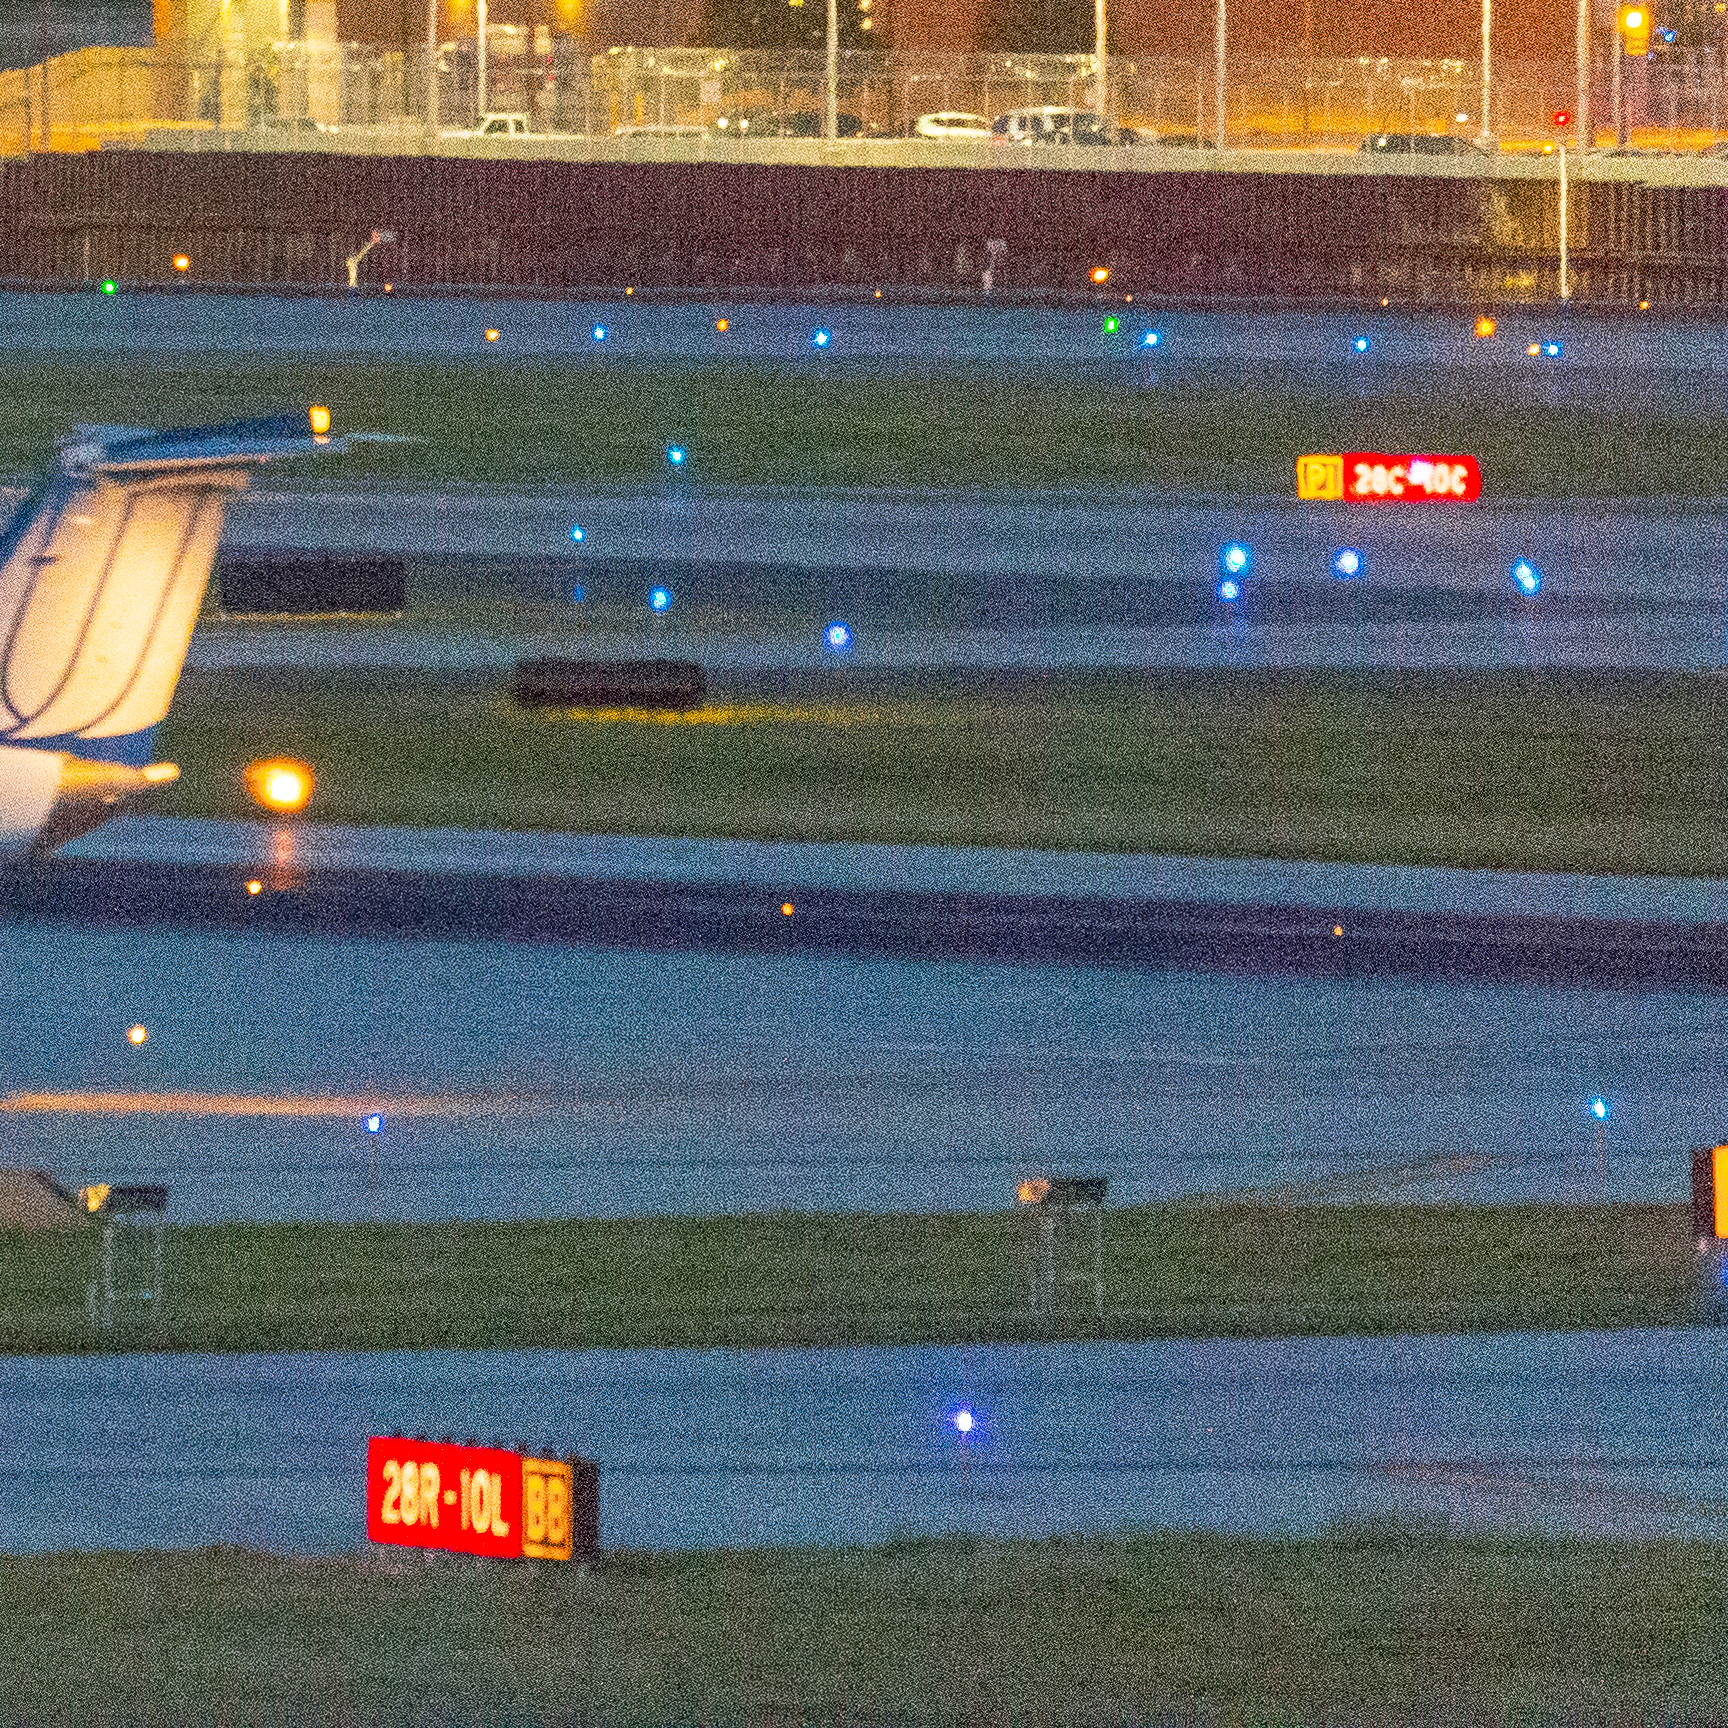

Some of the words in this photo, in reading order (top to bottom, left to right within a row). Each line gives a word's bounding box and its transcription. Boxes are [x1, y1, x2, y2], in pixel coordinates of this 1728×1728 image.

[1352, 459, 1468, 496] 28C10C
[380, 1458, 510, 1538] 28R-10L
[526, 1473, 566, 1543] BB
